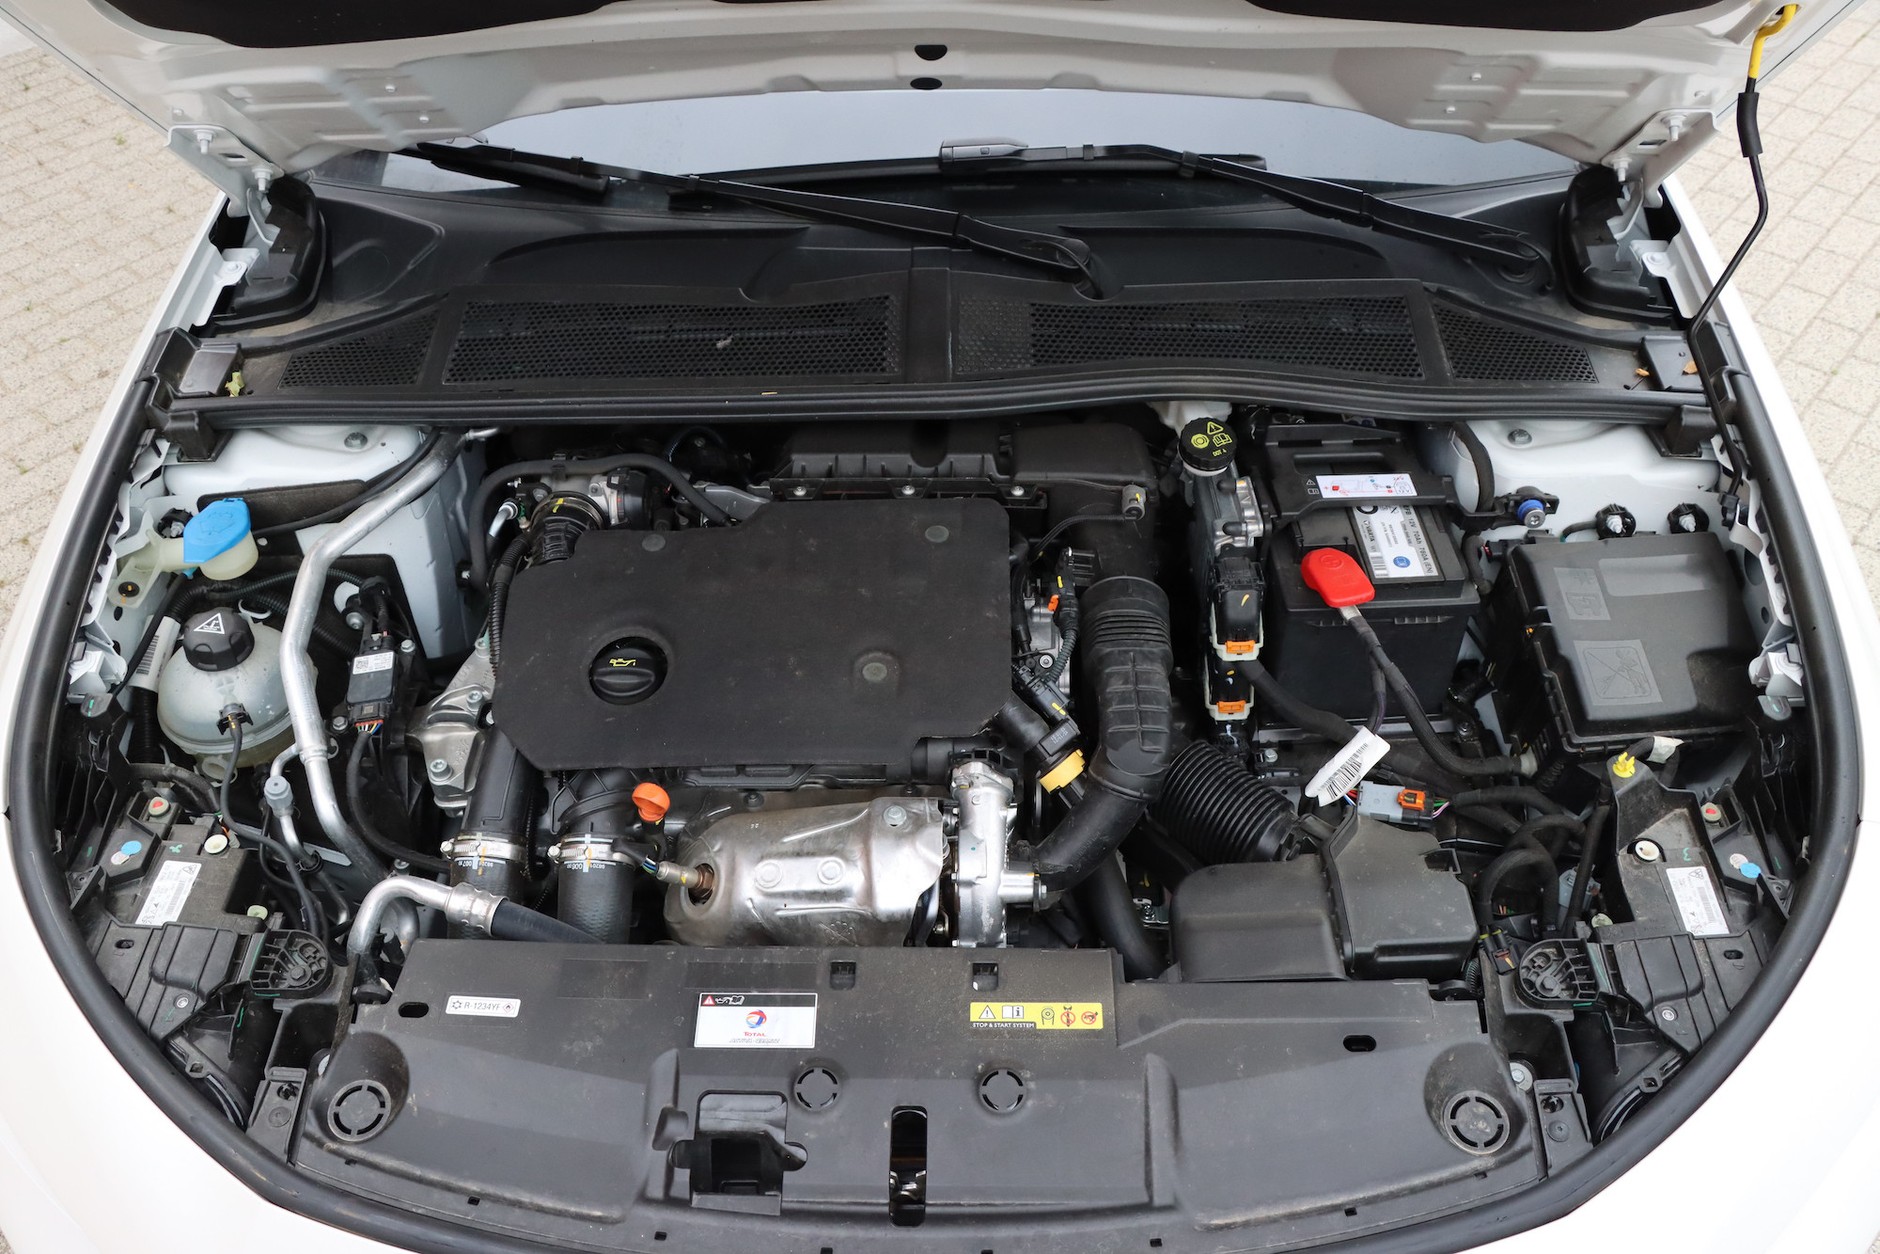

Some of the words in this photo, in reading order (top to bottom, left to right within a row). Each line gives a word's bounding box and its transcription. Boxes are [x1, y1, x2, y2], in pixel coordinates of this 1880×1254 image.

[1408, 518, 1417, 528] 12V
[1413, 530, 1422, 544] 70Ah
[463, 1001, 501, 1011] R-1234YF
